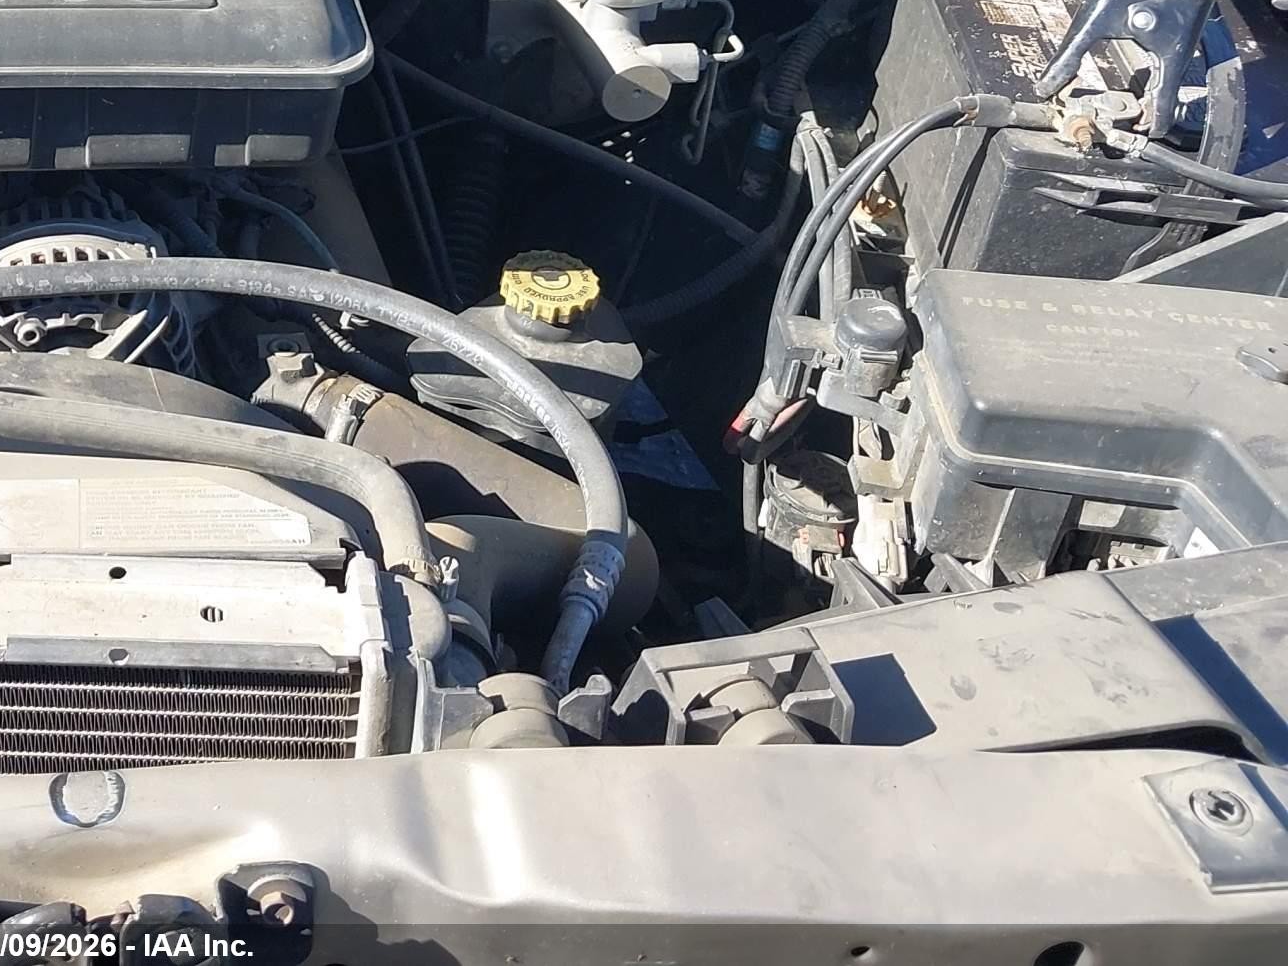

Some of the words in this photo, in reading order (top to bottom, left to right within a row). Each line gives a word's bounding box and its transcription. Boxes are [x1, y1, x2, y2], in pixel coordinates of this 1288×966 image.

[960, 296, 1030, 311] FUSE
[1041, 302, 1059, 313] &
[1070, 303, 1155, 320] RELAY
[1168, 311, 1273, 332] CENTER
[1045, 323, 1140, 338] CAUTION
